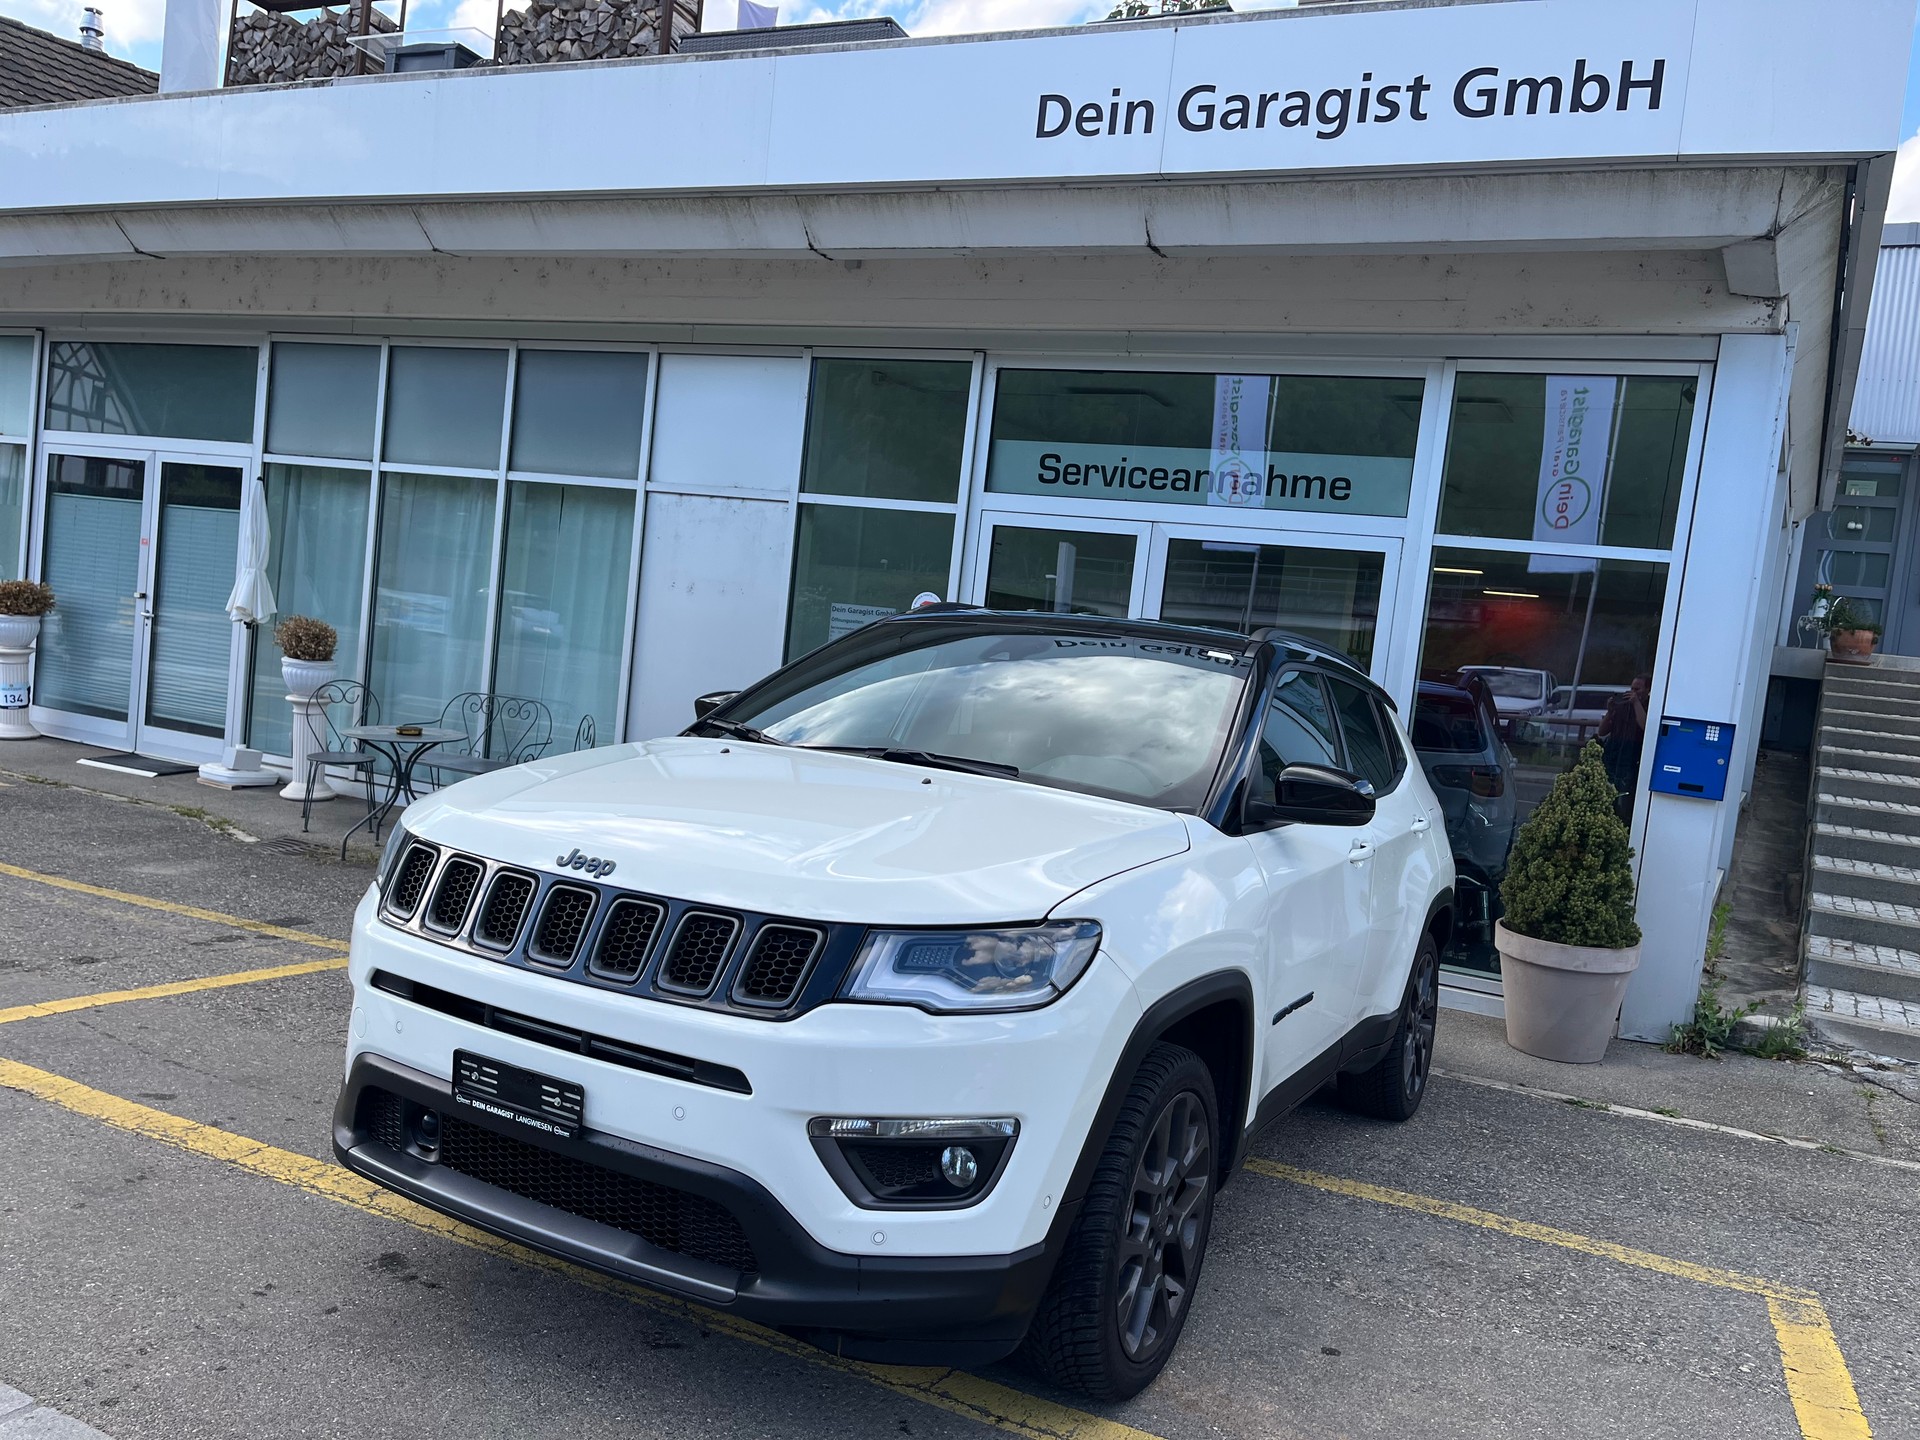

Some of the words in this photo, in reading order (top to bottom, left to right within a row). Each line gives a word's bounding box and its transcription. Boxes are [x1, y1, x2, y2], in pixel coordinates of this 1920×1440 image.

[1035, 88, 1155, 139] Dein
[1176, 72, 1432, 140] Garagist
[1452, 58, 1666, 119] GmbH
[1037, 452, 1353, 501] Serviceannahme
[832, 605, 846, 613] Dein
[847, 606, 874, 617] Garagist
[4, 694, 23, 703] 134
[556, 848, 617, 879] Jeep
[472, 1099, 486, 1110] DEIN
[486, 1104, 514, 1120] GARAGIST
[515, 1115, 553, 1132] LANGWIESEN
